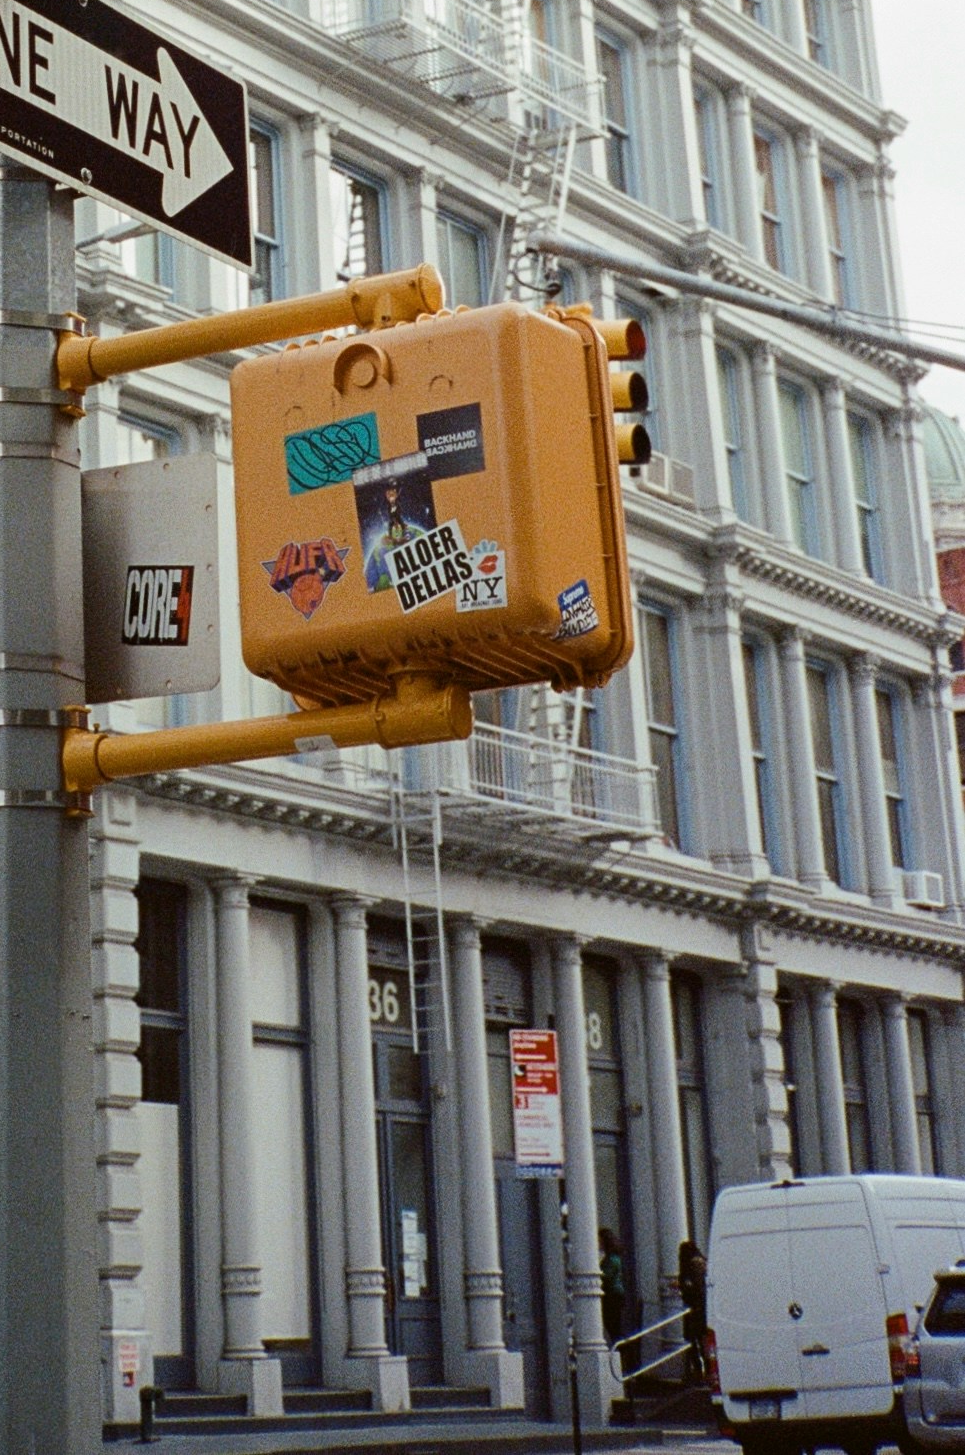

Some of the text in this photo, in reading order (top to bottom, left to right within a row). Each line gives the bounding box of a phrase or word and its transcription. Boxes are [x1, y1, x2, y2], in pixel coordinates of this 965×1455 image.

[104, 64, 200, 179] WAY
[424, 430, 476, 448] BACKHAND
[393, 526, 458, 580] ALOER
[123, 569, 182, 639] CORE
[396, 552, 473, 611] DELLAS
[460, 576, 503, 602] NY
[368, 979, 400, 1022] 36
[587, 1012, 603, 1050] 8
